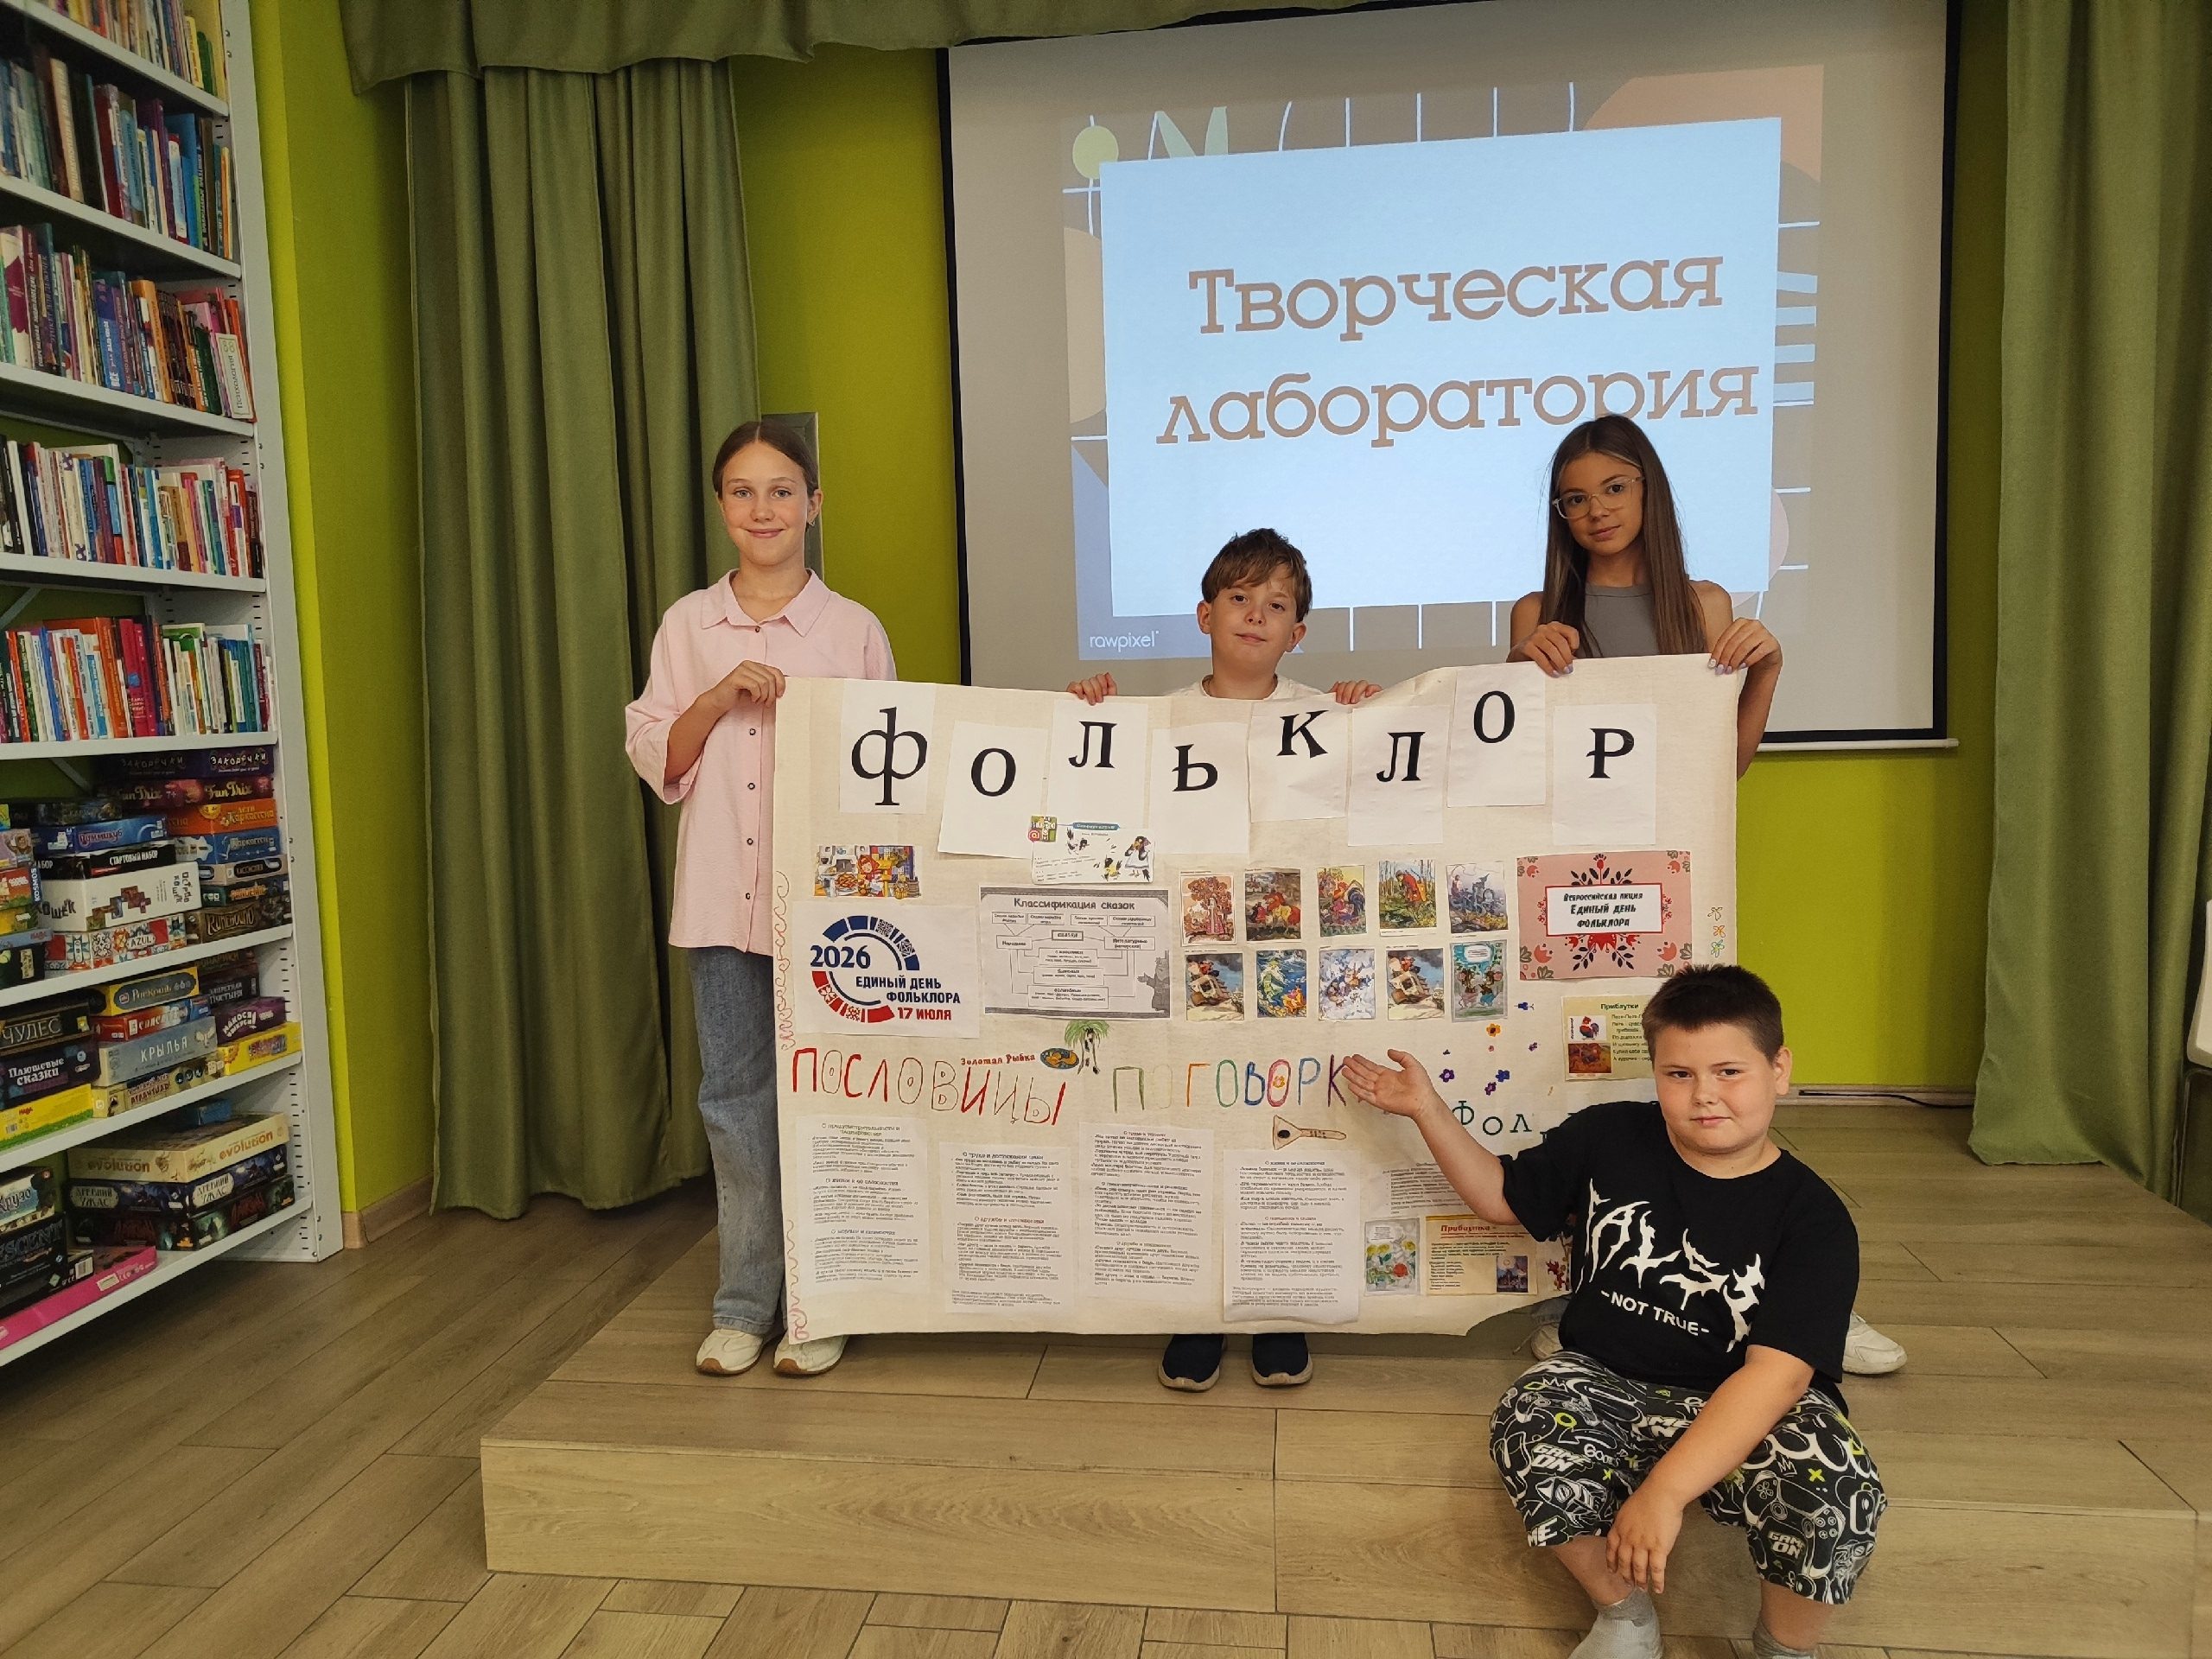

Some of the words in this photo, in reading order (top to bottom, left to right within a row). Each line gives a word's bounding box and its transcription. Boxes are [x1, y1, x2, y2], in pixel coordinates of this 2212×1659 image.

[1189, 256, 1723, 342] Творческая
[227, 354, 243, 409] Психология
[1156, 365, 1759, 448] лаборатория
[1089, 628, 1160, 652] rawpixel
[109, 852, 140, 866] СТАРТОВЫЙ
[140, 850, 159, 861] НАБОР
[30, 868, 41, 902] KOSMOS
[1014, 898, 1096, 911] Классификация
[1101, 901, 1135, 910] сказок
[1613, 904, 1637, 914] ДЕНЬ
[1577, 918, 1630, 928] ФОЛЬКЛОРА
[130, 936, 152, 947] AZUL
[810, 944, 872, 969] 2026
[855, 974, 907, 990] ЕДИНЫЙ
[910, 976, 942, 991] ДЕНЬ
[886, 988, 961, 1005] ФОЛЬКЛОРА
[897, 1007, 912, 1020] 17
[916, 1007, 951, 1020] ИЮЛЯ
[3, 1018, 61, 1044] ЧУДЕС
[140, 1035, 188, 1063] КРЫЛЬЯ
[960, 1056, 1003, 1067] Золотая
[1006, 1053, 1036, 1065] Рыбка
[9, 1057, 65, 1078] Плюшевые
[16, 1067, 60, 1086] сказки
[792, 1046, 1067, 1127] ПОСЛОВИЦЫ
[1112, 1052, 1366, 1115] ПОГОВОРК
[219, 1131, 273, 1160] evolution
